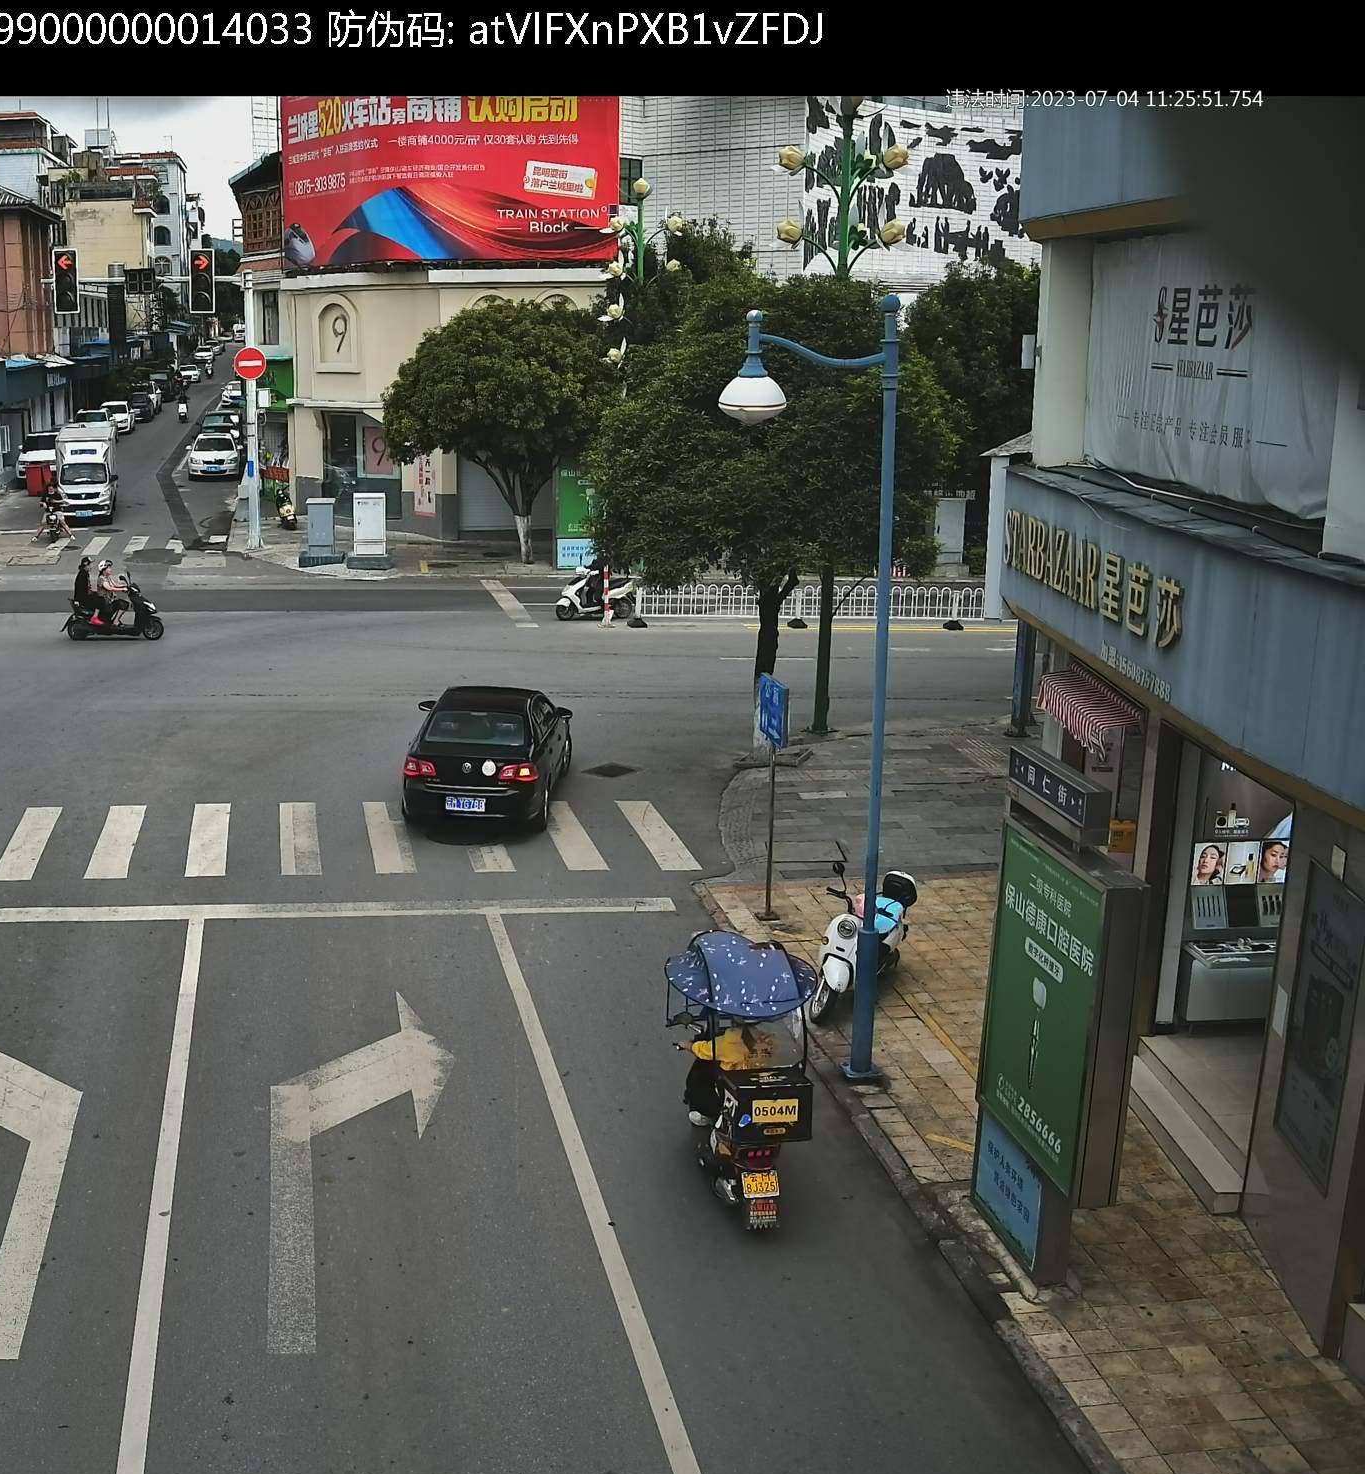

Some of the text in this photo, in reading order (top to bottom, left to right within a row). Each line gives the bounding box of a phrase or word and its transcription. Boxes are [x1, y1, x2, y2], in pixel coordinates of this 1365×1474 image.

[497, 208, 538, 219] TRAIN
[529, 221, 569, 233] Block
[1167, 283, 1256, 350] 星芭莎
[1003, 509, 1183, 649] STARBAZAAR 星芭莎
[1027, 764, 1068, 807] 同仁街
[1005, 882, 1095, 977] 保山德康口腔医院
[754, 1105, 797, 1117] 0504M
[1017, 1096, 1062, 1155] 2856666
[746, 1181, 776, 1193] 8J325
